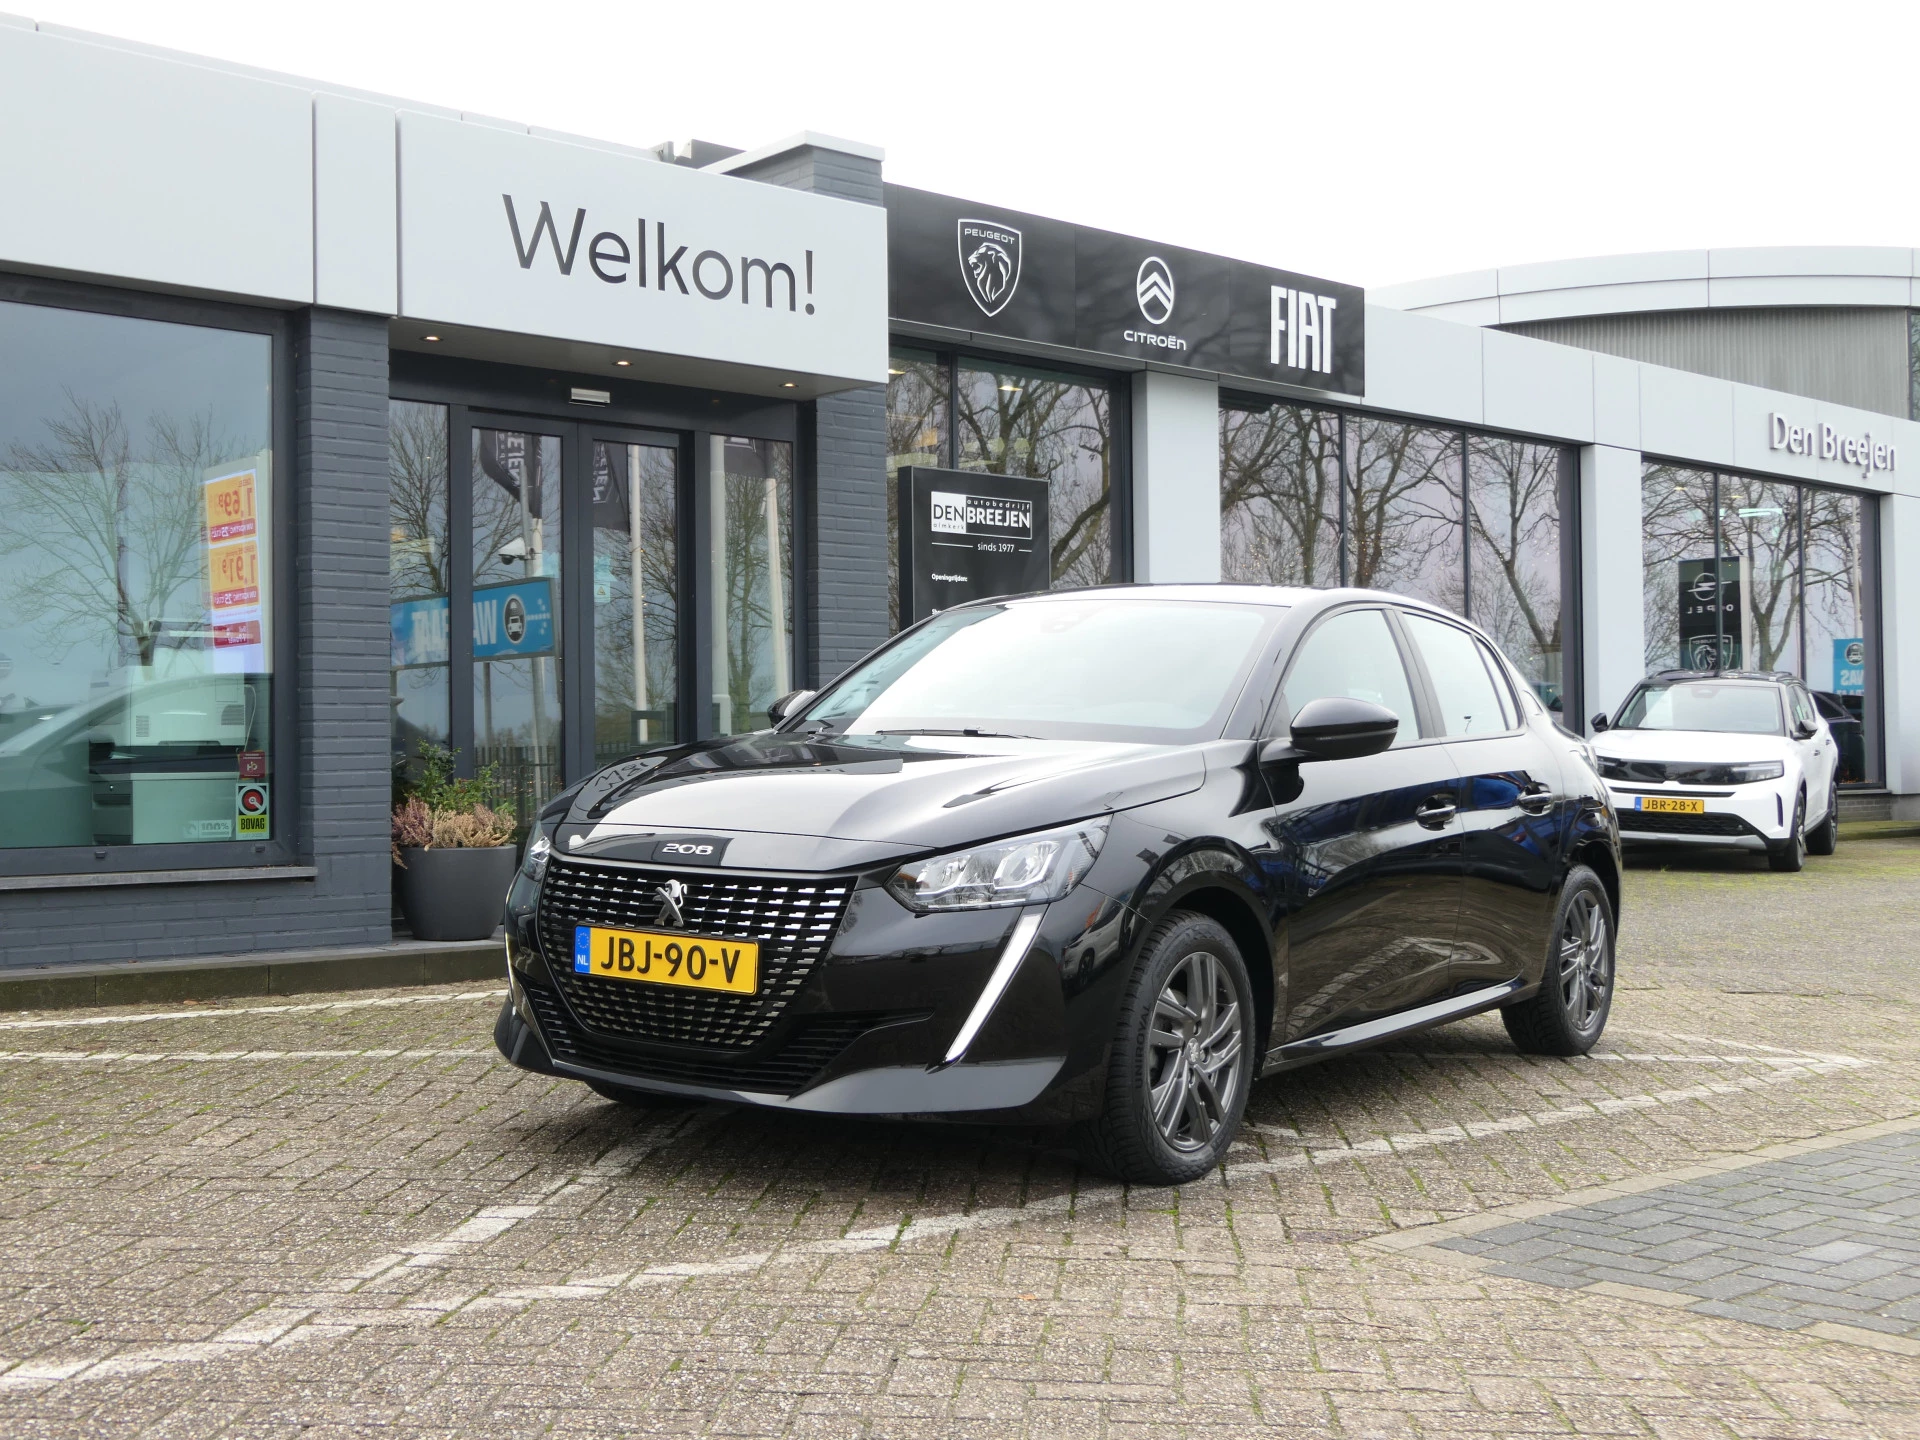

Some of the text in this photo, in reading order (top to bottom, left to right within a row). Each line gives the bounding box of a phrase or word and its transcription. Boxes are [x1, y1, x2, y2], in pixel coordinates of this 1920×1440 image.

[964, 228, 1015, 245] PEUGEOT
[501, 193, 815, 316] Welkom!
[1269, 285, 1337, 374] FIAT
[1769, 411, 1897, 479] Den Breejen
[966, 499, 1030, 511] autobedrijf
[933, 504, 1030, 529] DEN BREEJEN
[977, 542, 1015, 553] sinds 1977
[1644, 799, 1698, 812] JBR-28-X
[240, 817, 265, 830] BOVAG
[661, 842, 714, 856] 208
[577, 935, 741, 985] NL JBJ-90-V
[1135, 1006, 1150, 1089] UNIROYAL
